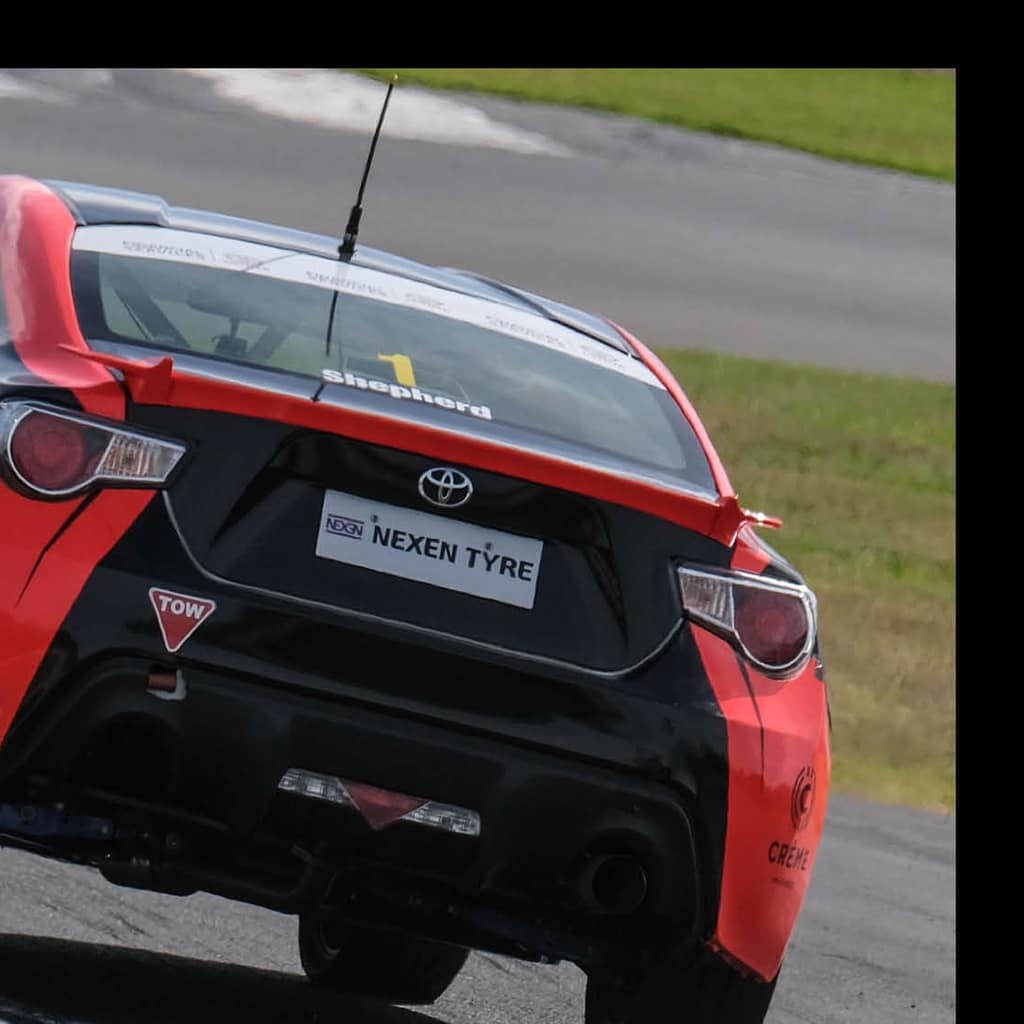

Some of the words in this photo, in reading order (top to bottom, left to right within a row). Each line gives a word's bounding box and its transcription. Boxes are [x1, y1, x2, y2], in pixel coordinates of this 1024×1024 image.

[378, 353, 417, 388] 1
[321, 368, 493, 421] Shepherd
[372, 525, 459, 564] NEXEN
[465, 547, 535, 582] TYRE
[158, 594, 205, 620] TOW
